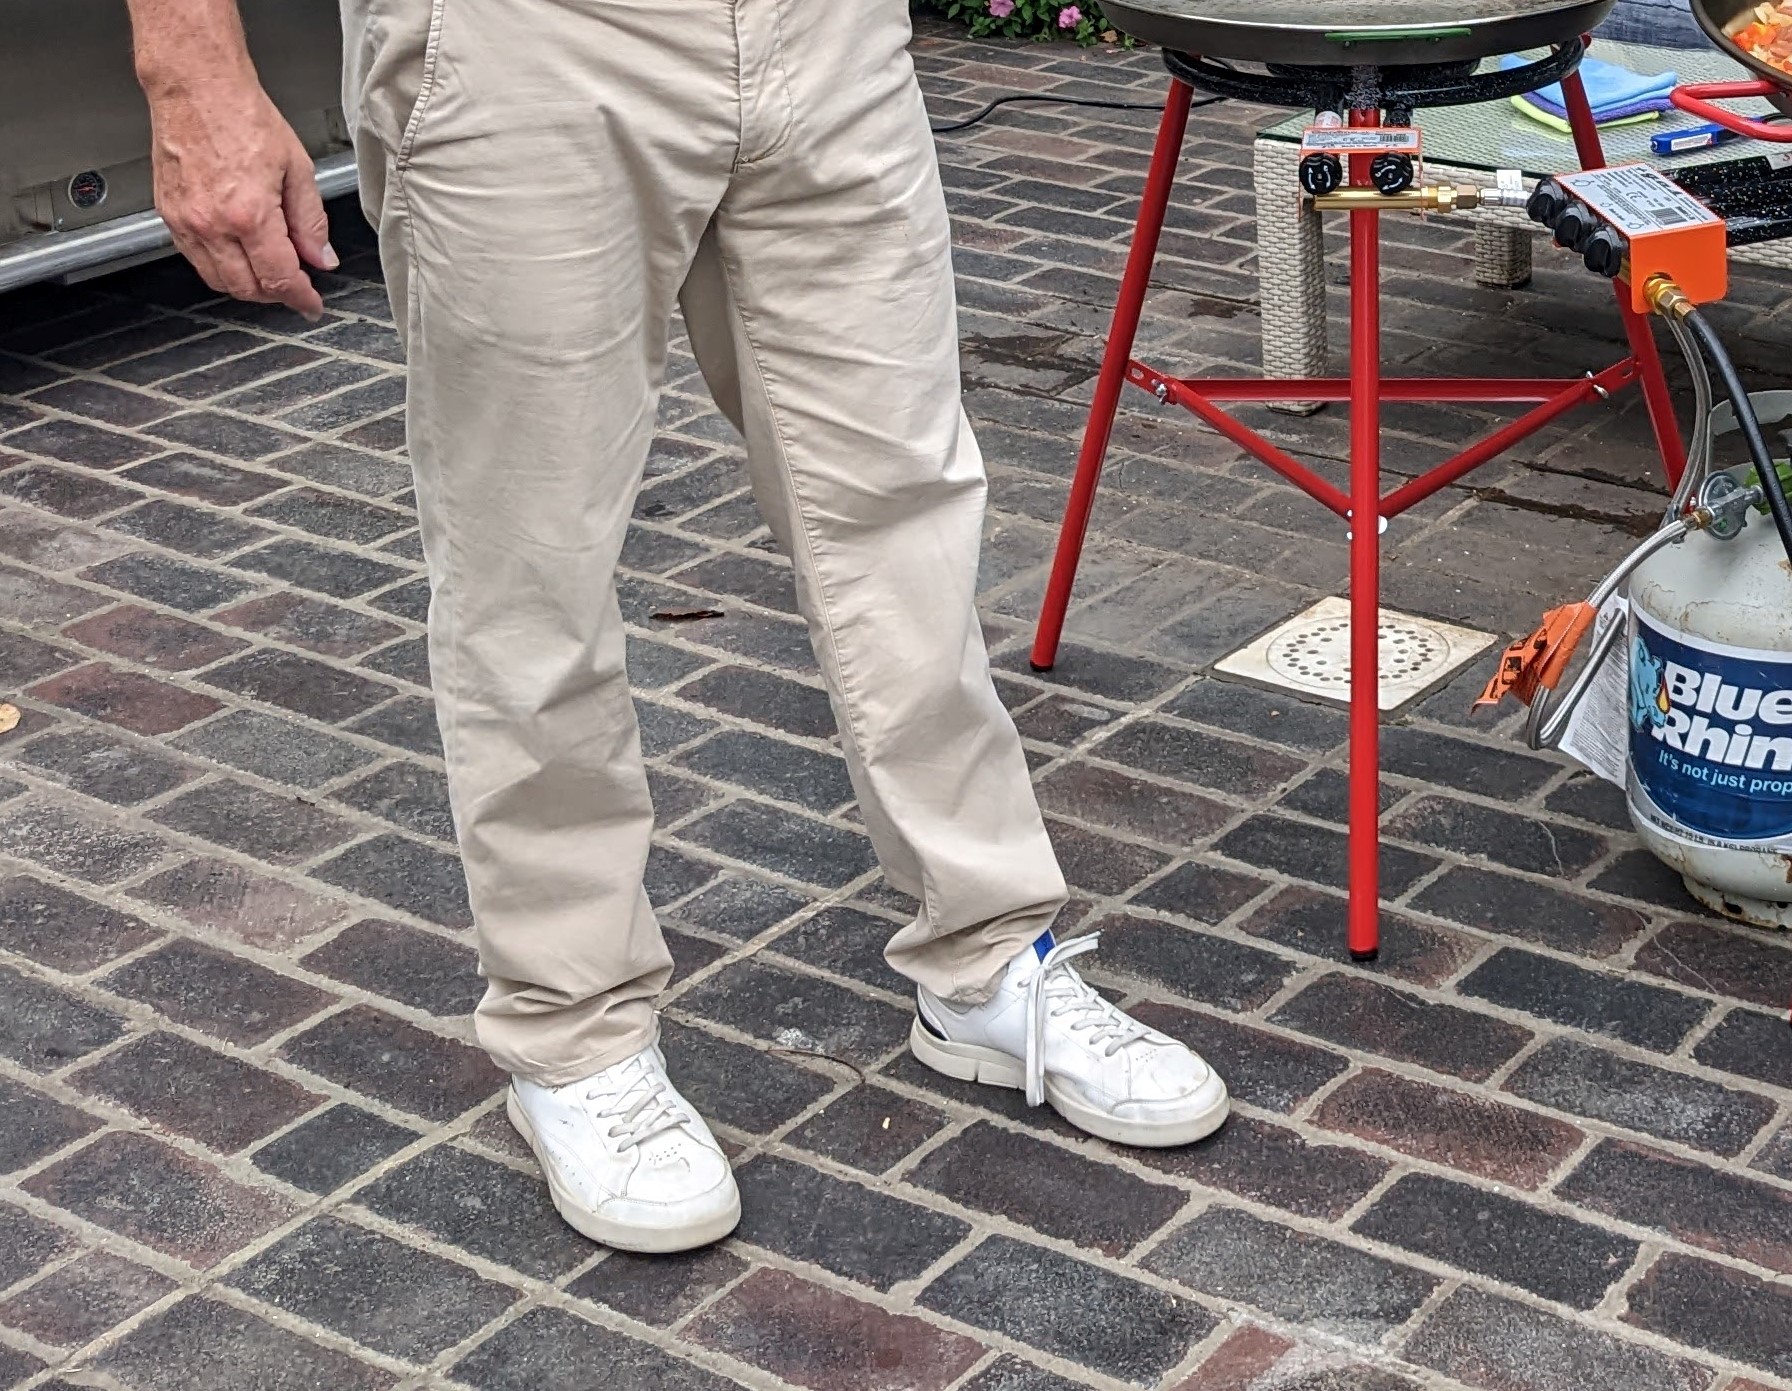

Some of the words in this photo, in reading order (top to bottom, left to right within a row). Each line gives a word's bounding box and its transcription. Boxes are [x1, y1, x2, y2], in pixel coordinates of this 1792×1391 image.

[1658, 749, 1679, 769] It's
[1682, 763, 1709, 781] not
[1710, 770, 1746, 789] just
